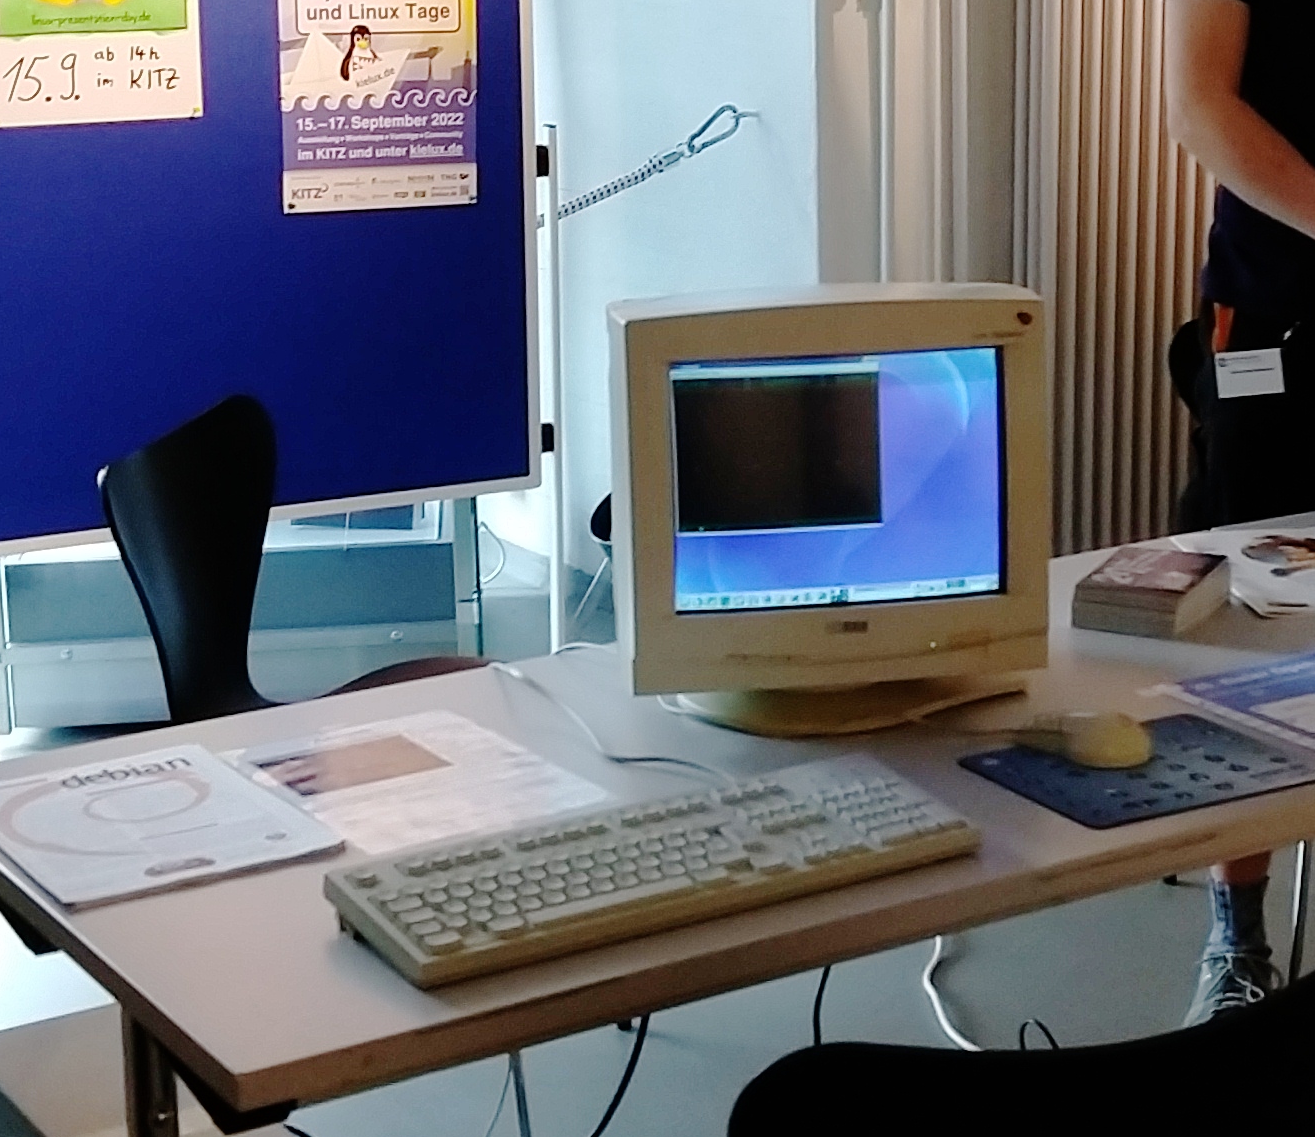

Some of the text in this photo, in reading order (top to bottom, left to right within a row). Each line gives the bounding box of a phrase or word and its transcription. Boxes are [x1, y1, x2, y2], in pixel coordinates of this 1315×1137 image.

[307, 3, 450, 23] und Linux Tage
[94, 46, 115, 61] ab
[97, 68, 181, 90] im KITZ
[351, 113, 427, 133] September
[430, 112, 464, 127] 2022
[316, 146, 347, 160] KITZ
[349, 145, 373, 159] und
[375, 145, 408, 158] unter
[291, 188, 323, 200] KITZ
[61, 755, 192, 790] debian
